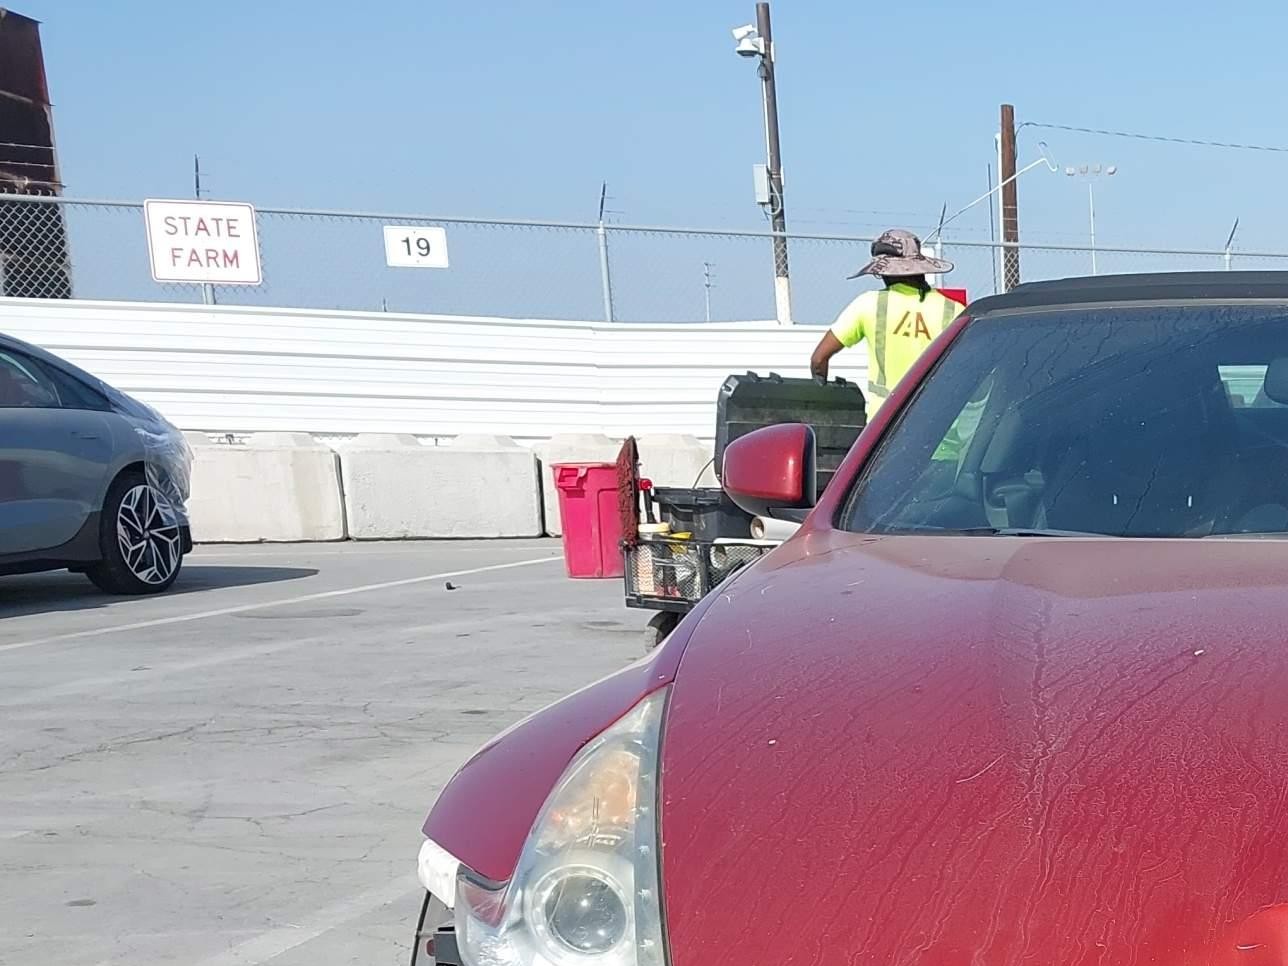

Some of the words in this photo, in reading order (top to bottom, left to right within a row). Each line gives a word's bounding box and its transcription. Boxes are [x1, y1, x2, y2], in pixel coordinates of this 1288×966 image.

[163, 215, 241, 238] STATE
[401, 236, 431, 257] 19
[170, 247, 240, 269] FARM
